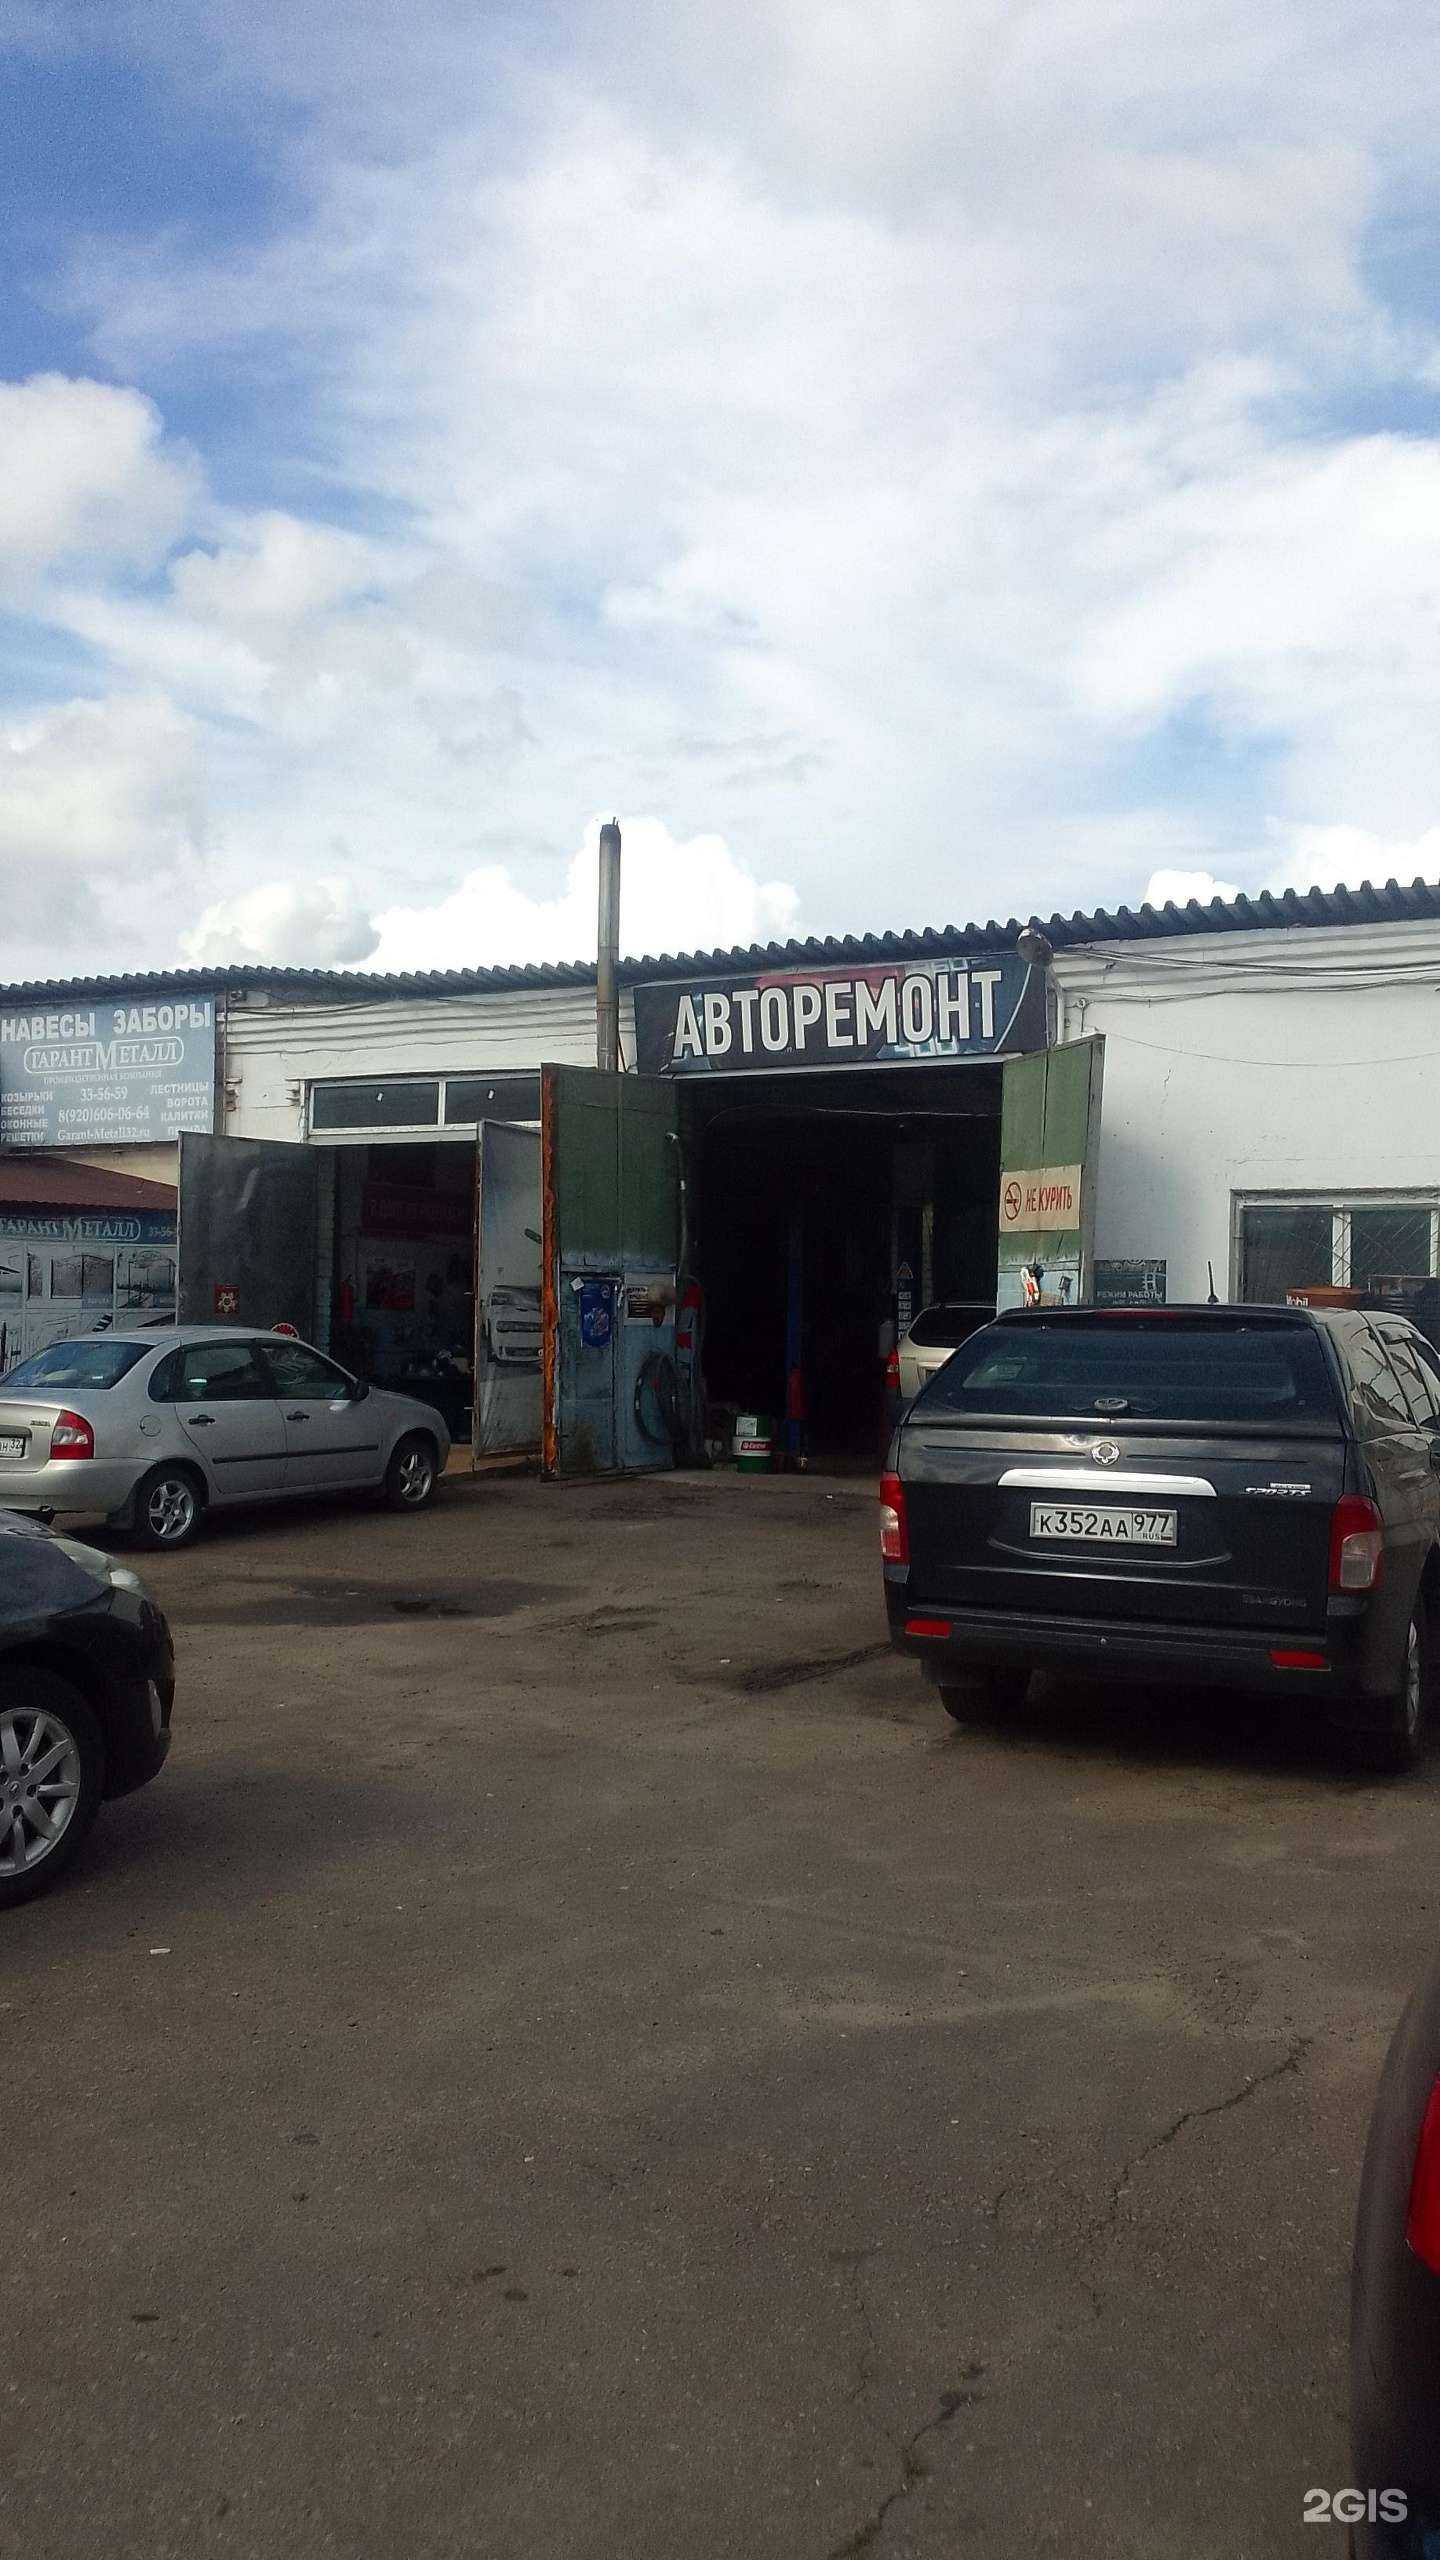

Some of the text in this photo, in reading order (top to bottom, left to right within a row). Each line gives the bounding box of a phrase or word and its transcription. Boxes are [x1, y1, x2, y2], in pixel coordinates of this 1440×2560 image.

[1, 1002, 211, 1042] НАВЕСЫ ЗАБОРЫ
[672, 970, 1002, 1058] АВТОРЕМОНТ
[31, 1048, 94, 1069] ГАРАНТ
[150, 1081, 209, 1096] ЛЕСТНИЦЫ
[0, 1105, 45, 1116] БЕСЕДКИ
[167, 1096, 209, 1108] ВОРОТА
[0, 1119, 49, 1130] ОКОННЫЕ
[1025, 1185, 1073, 1212] НЕ КУРИТЬ
[1128, 1290, 1163, 1299] РАБОТЫ
[1040, 1511, 1171, 1538] К352АА 977
